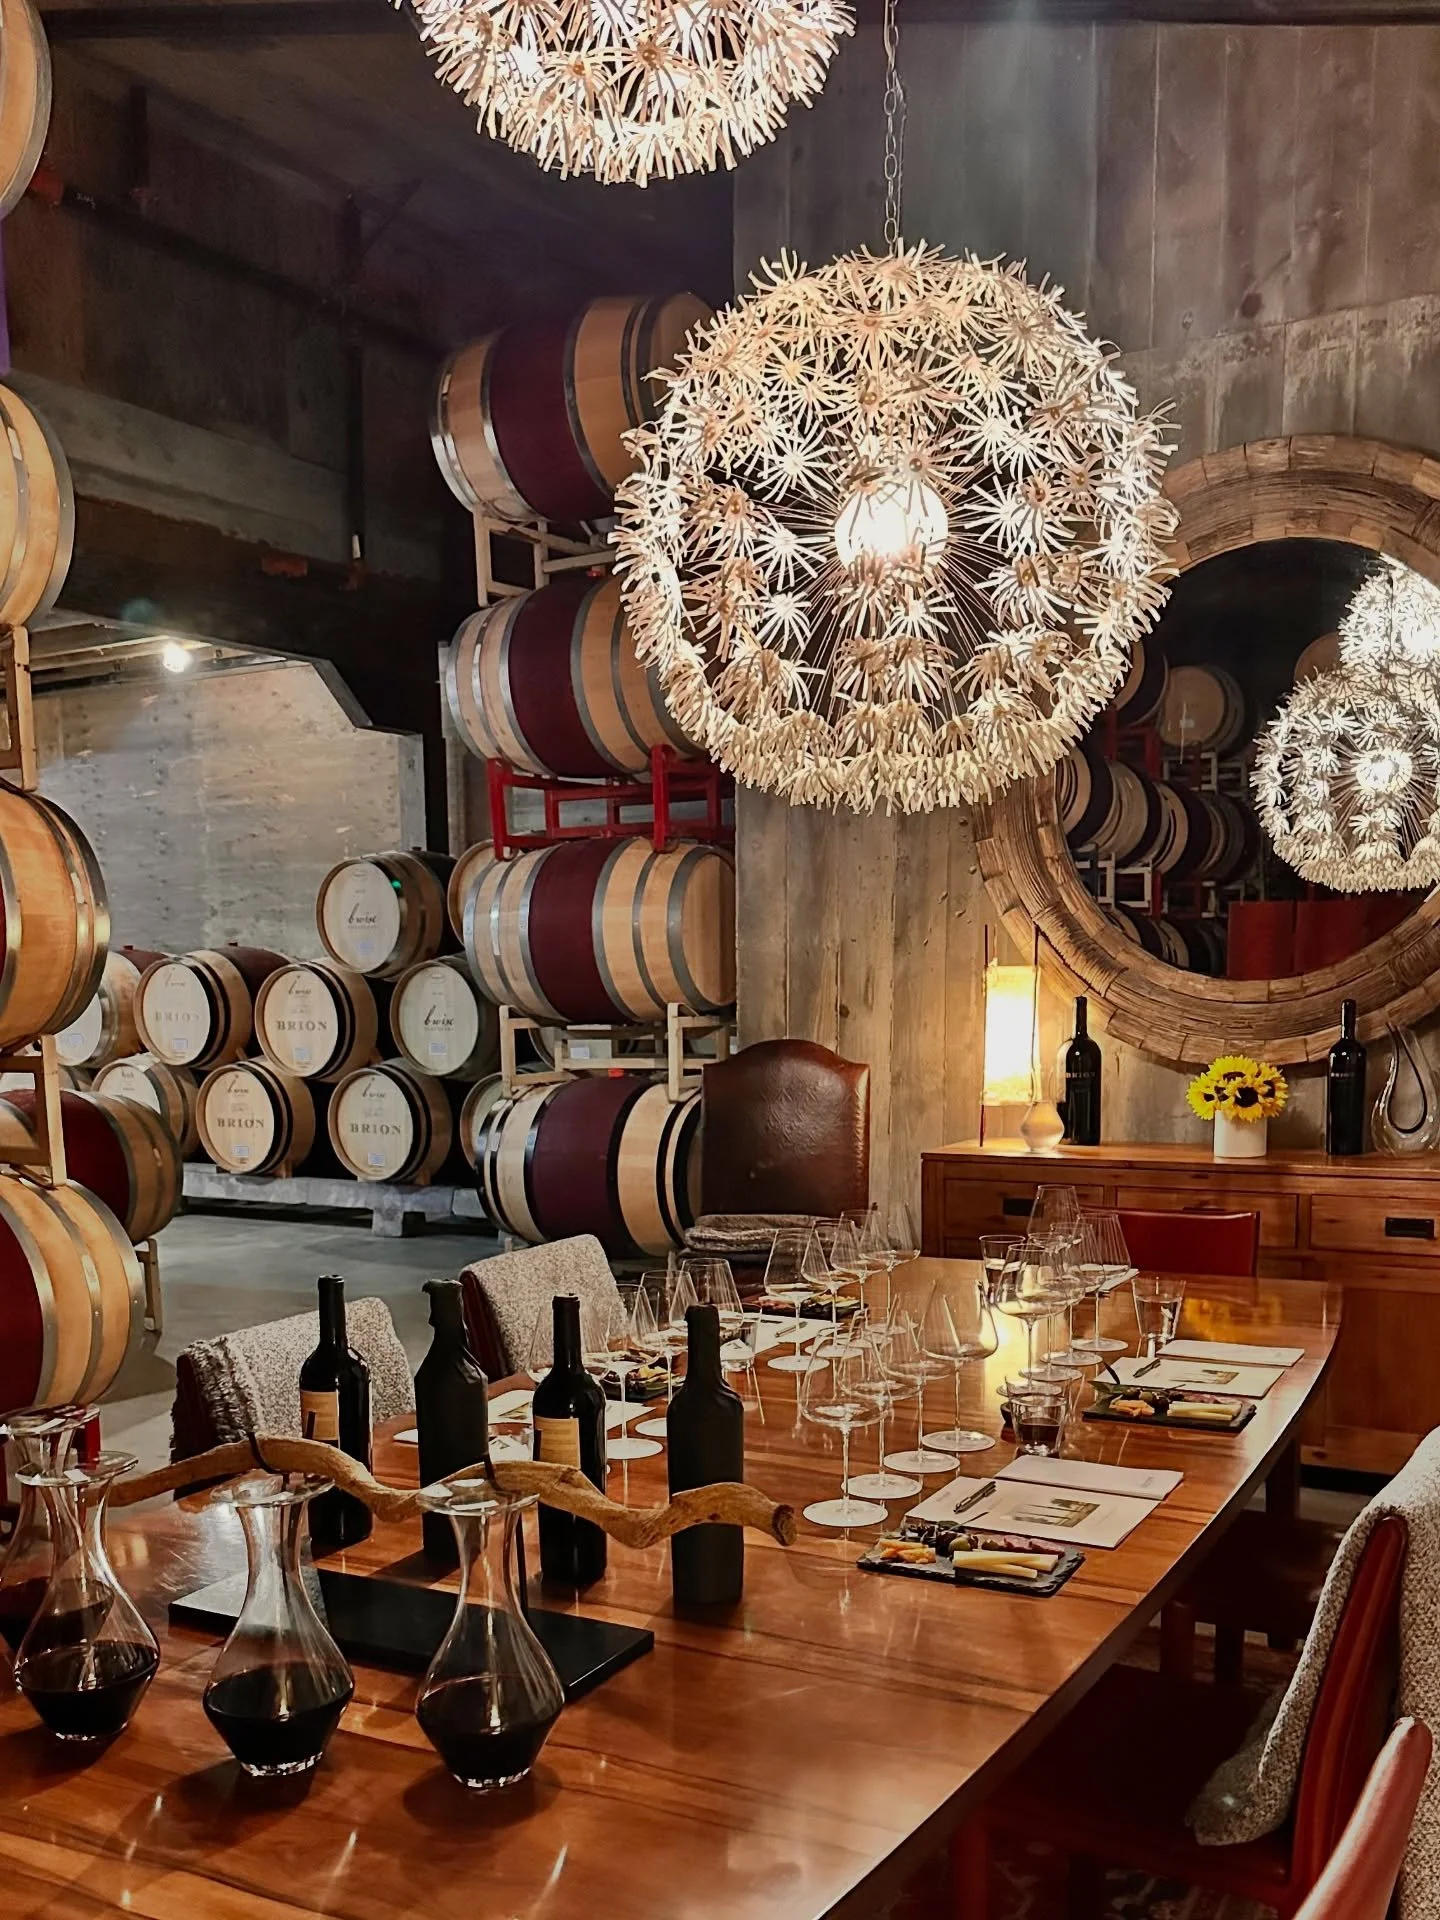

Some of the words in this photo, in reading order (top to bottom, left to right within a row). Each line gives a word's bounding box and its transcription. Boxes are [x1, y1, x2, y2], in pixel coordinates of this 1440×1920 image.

[277, 1020, 327, 1032] BRION
[217, 1117, 264, 1129] BRION
[350, 1123, 402, 1136] BRION
